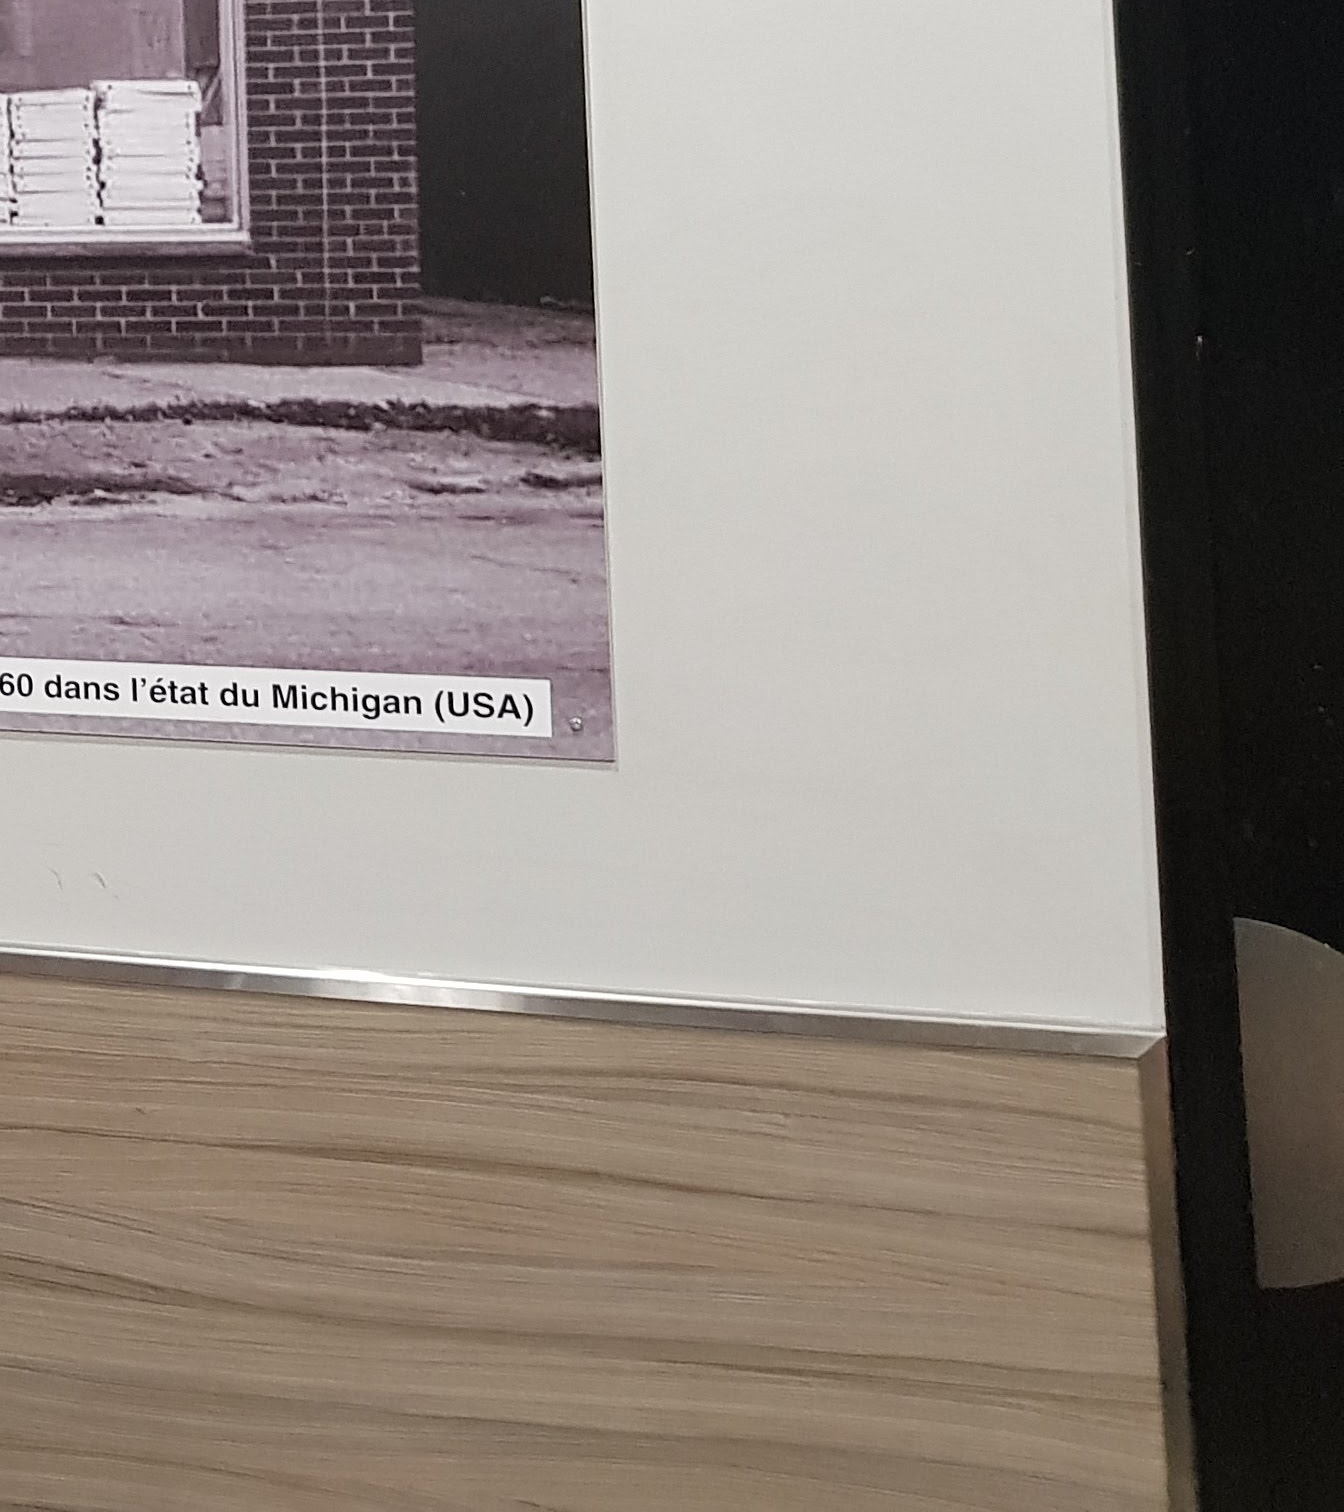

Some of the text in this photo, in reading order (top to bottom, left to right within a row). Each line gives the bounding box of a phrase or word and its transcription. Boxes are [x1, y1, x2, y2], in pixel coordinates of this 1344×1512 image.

[44, 672, 120, 701] dans
[131, 677, 209, 706] l’état
[219, 681, 259, 708] du
[271, 684, 422, 720] Michigan
[434, 690, 535, 727] (USA)
